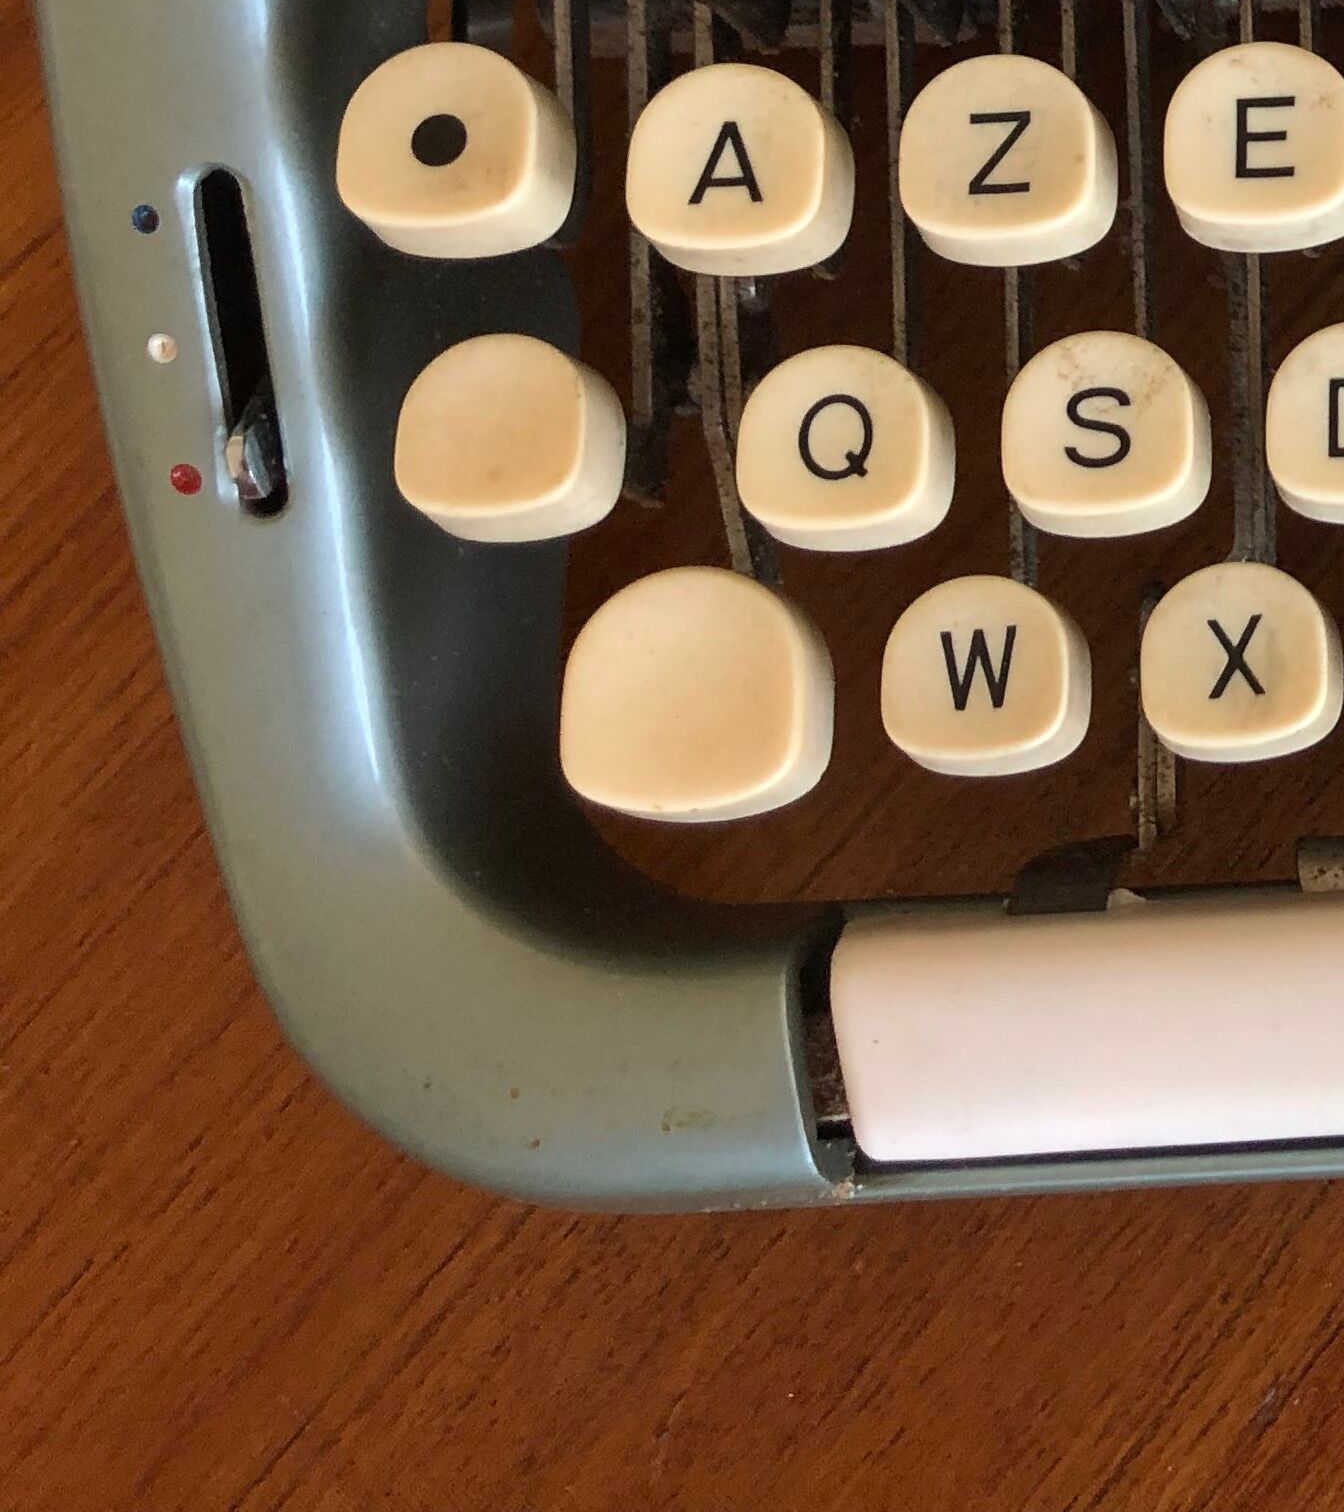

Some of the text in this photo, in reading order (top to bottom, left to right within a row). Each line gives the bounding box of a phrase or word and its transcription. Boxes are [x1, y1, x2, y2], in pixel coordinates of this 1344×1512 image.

[687, 121, 764, 205] A
[968, 110, 1031, 196] Z
[1235, 95, 1296, 179] E
[798, 393, 874, 481] Q
[1064, 387, 1131, 469] S
[940, 624, 1017, 712] W
[1207, 613, 1266, 700] X
